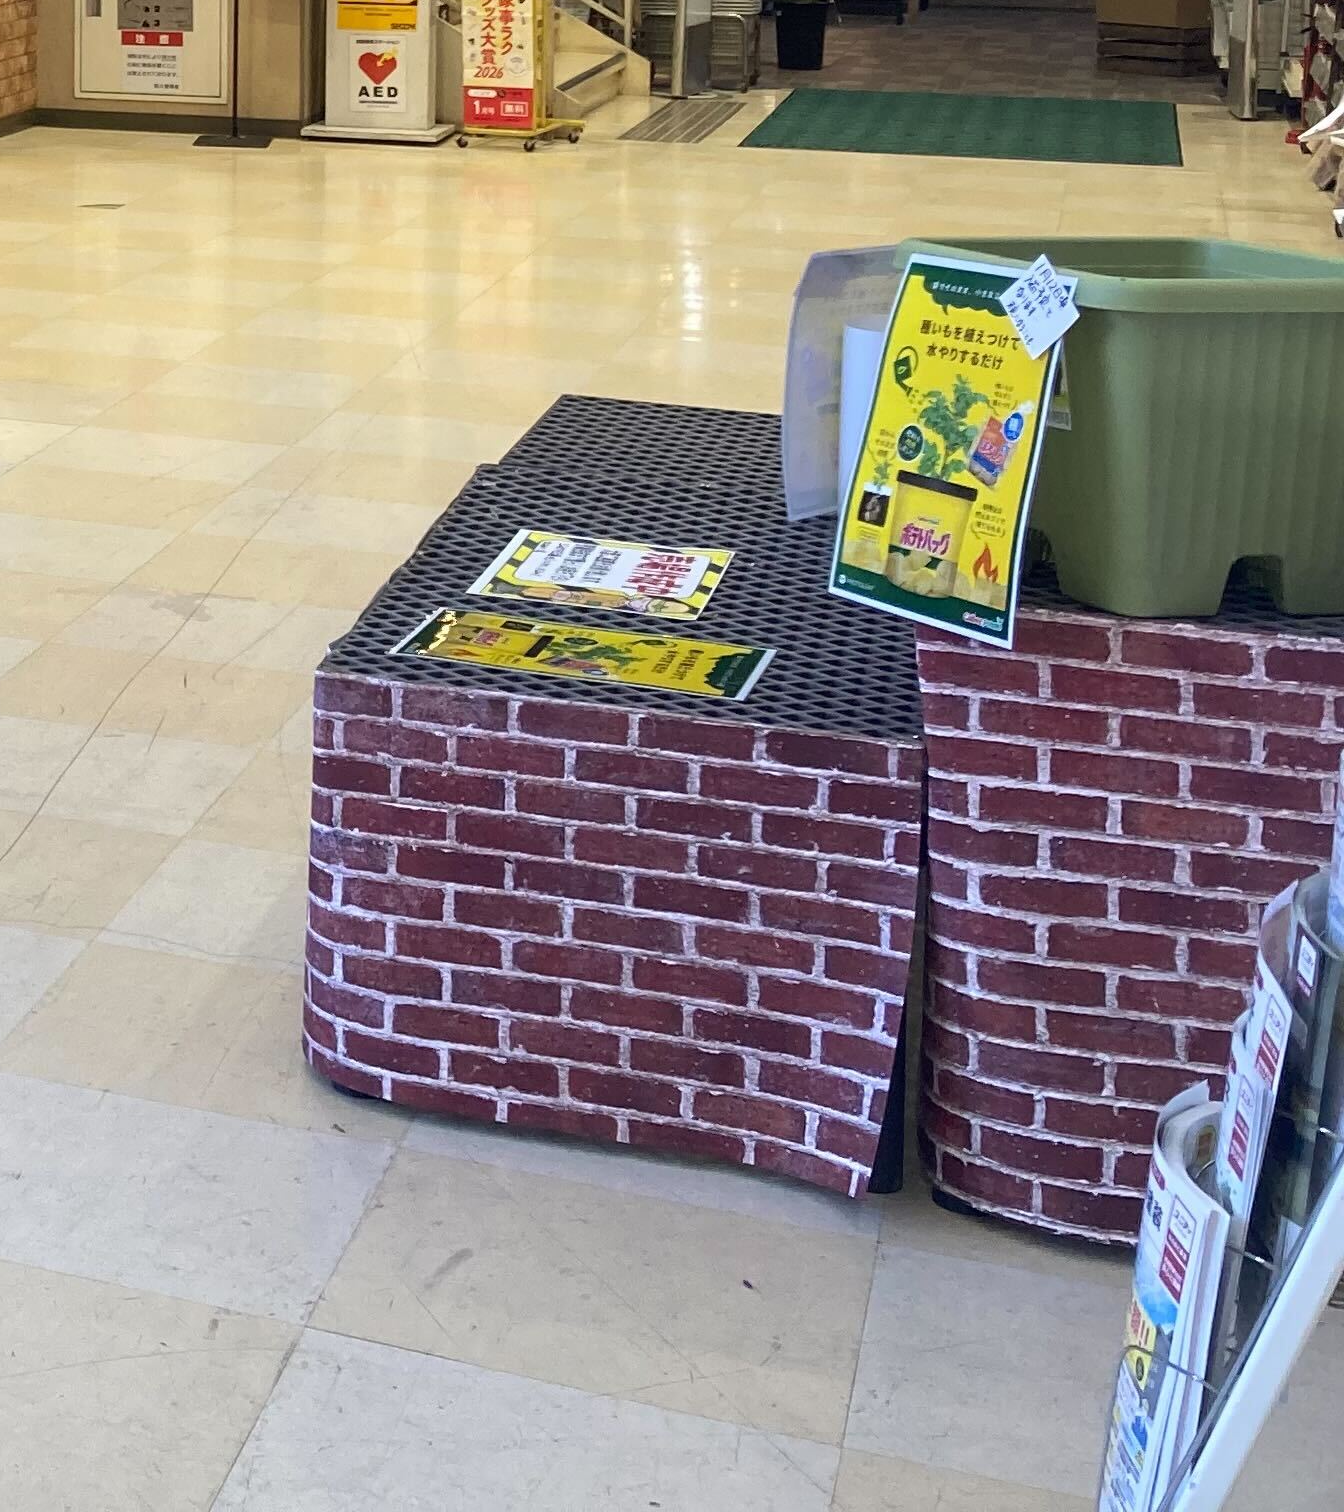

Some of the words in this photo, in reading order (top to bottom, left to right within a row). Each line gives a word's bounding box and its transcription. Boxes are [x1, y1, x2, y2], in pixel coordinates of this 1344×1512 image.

[358, 86, 399, 98] AED
[925, 343, 1005, 371] 水やりするだけ
[900, 521, 952, 558] ポテトバッグ
